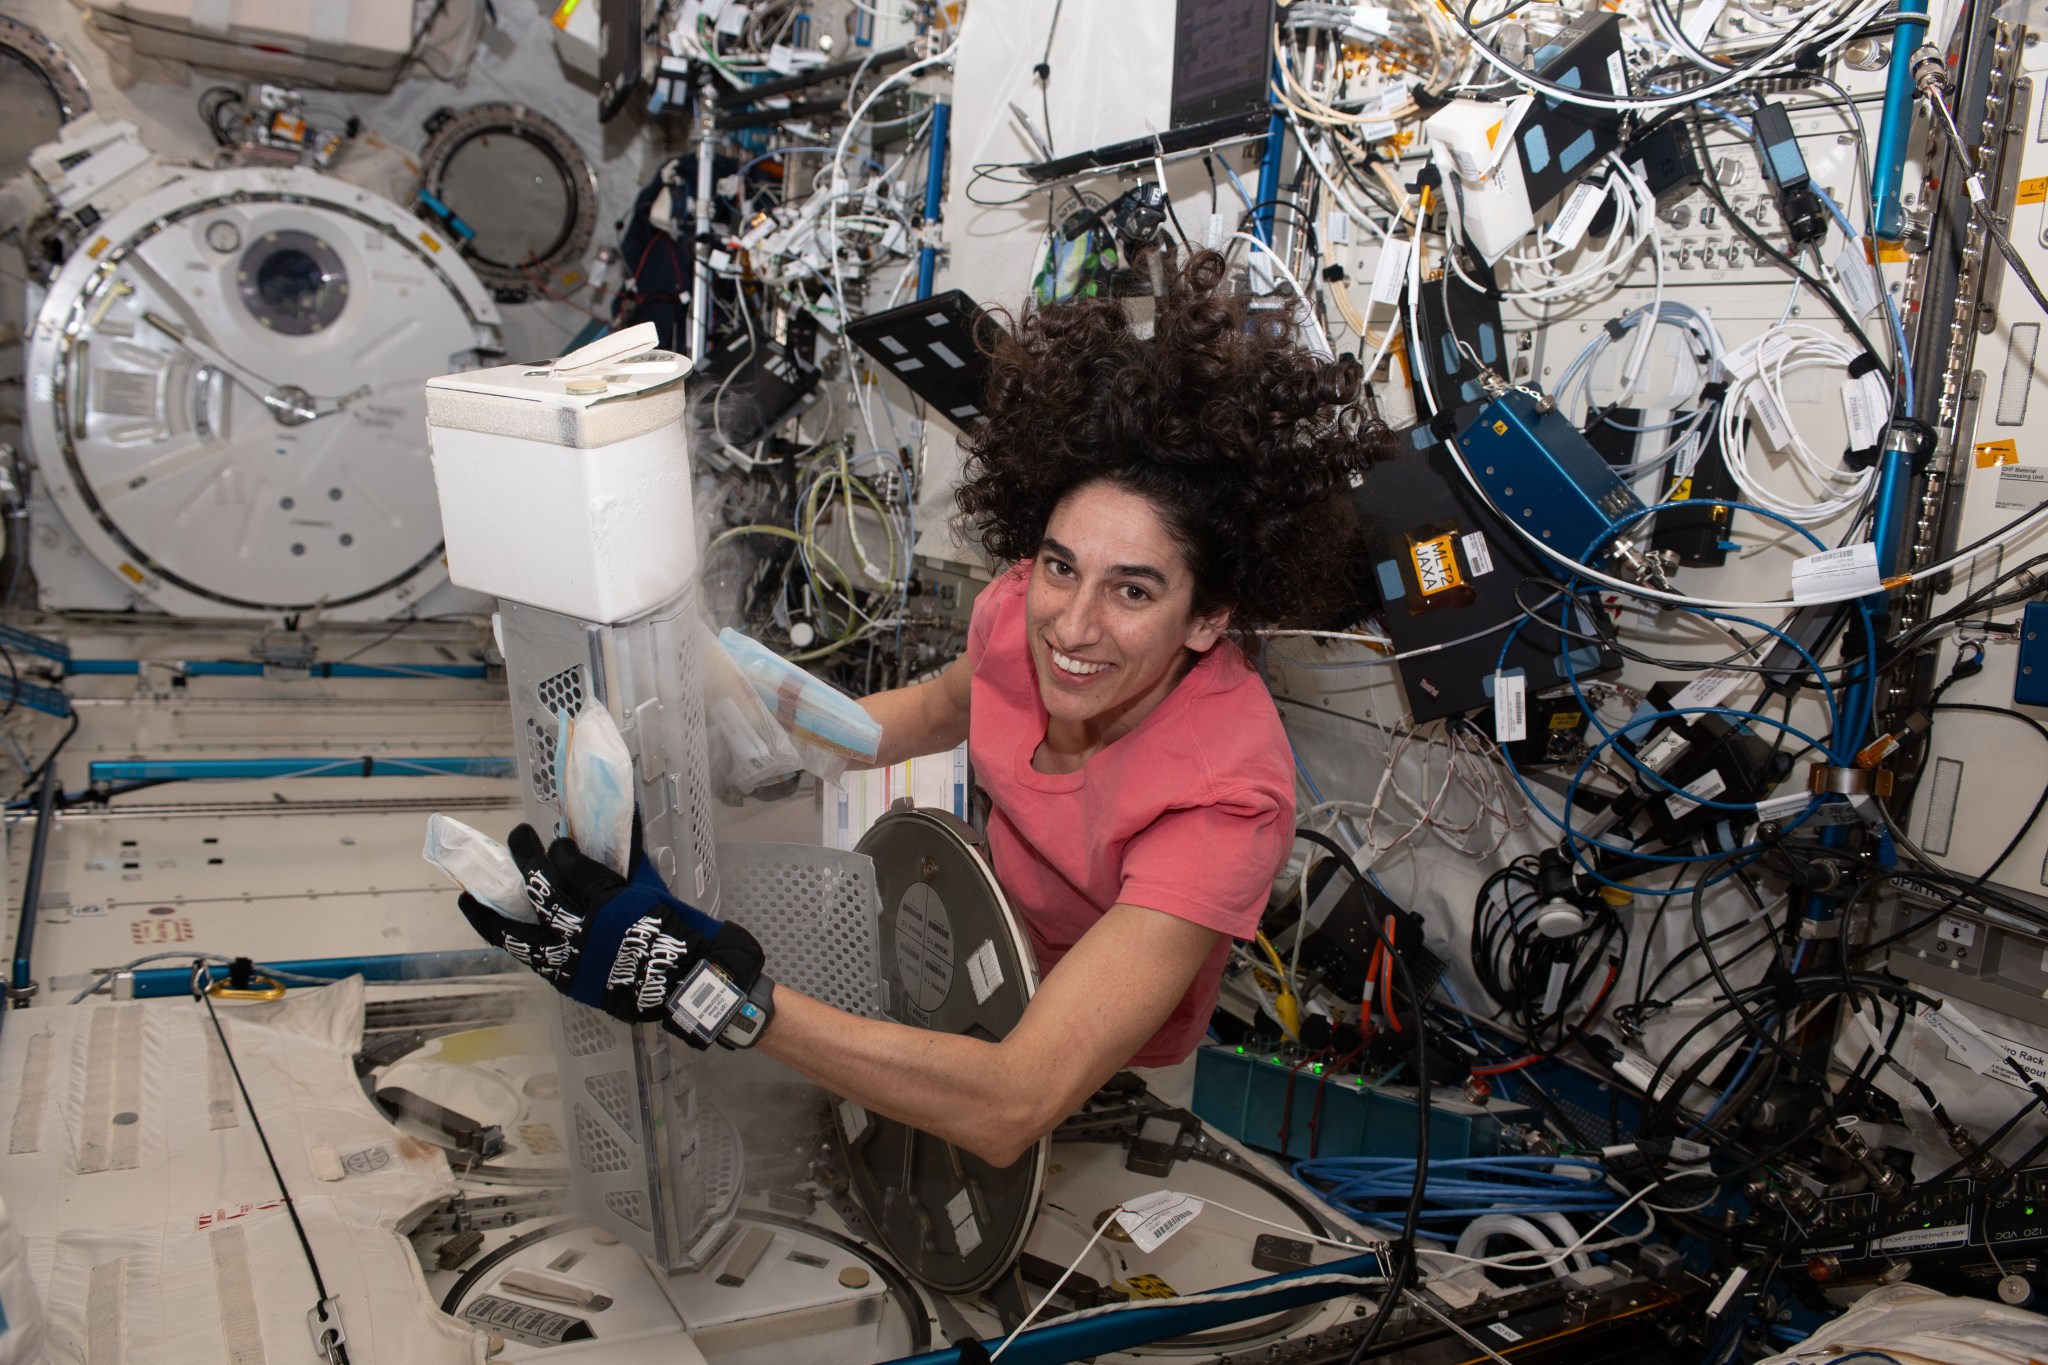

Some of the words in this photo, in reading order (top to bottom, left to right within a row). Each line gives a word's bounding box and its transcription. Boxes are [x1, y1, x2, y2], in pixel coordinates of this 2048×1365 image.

[2000, 472, 2032, 480] Processing
[1415, 547, 1437, 591] JAXA
[1431, 540, 1455, 587] MLT2
[1418, 677, 1440, 698] ThinkPad
[912, 1006, 929, 1025] DEWAR
[1937, 1022, 1950, 1035] Power
[2019, 1050, 2045, 1066] Rack
[1885, 1236, 1906, 1244] PORT
[1908, 1231, 1950, 1242] ETHERNET
[1951, 1229, 1966, 1237] SW
[1995, 1230, 2018, 1241] VDC
[2023, 1226, 2043, 1238] 120
